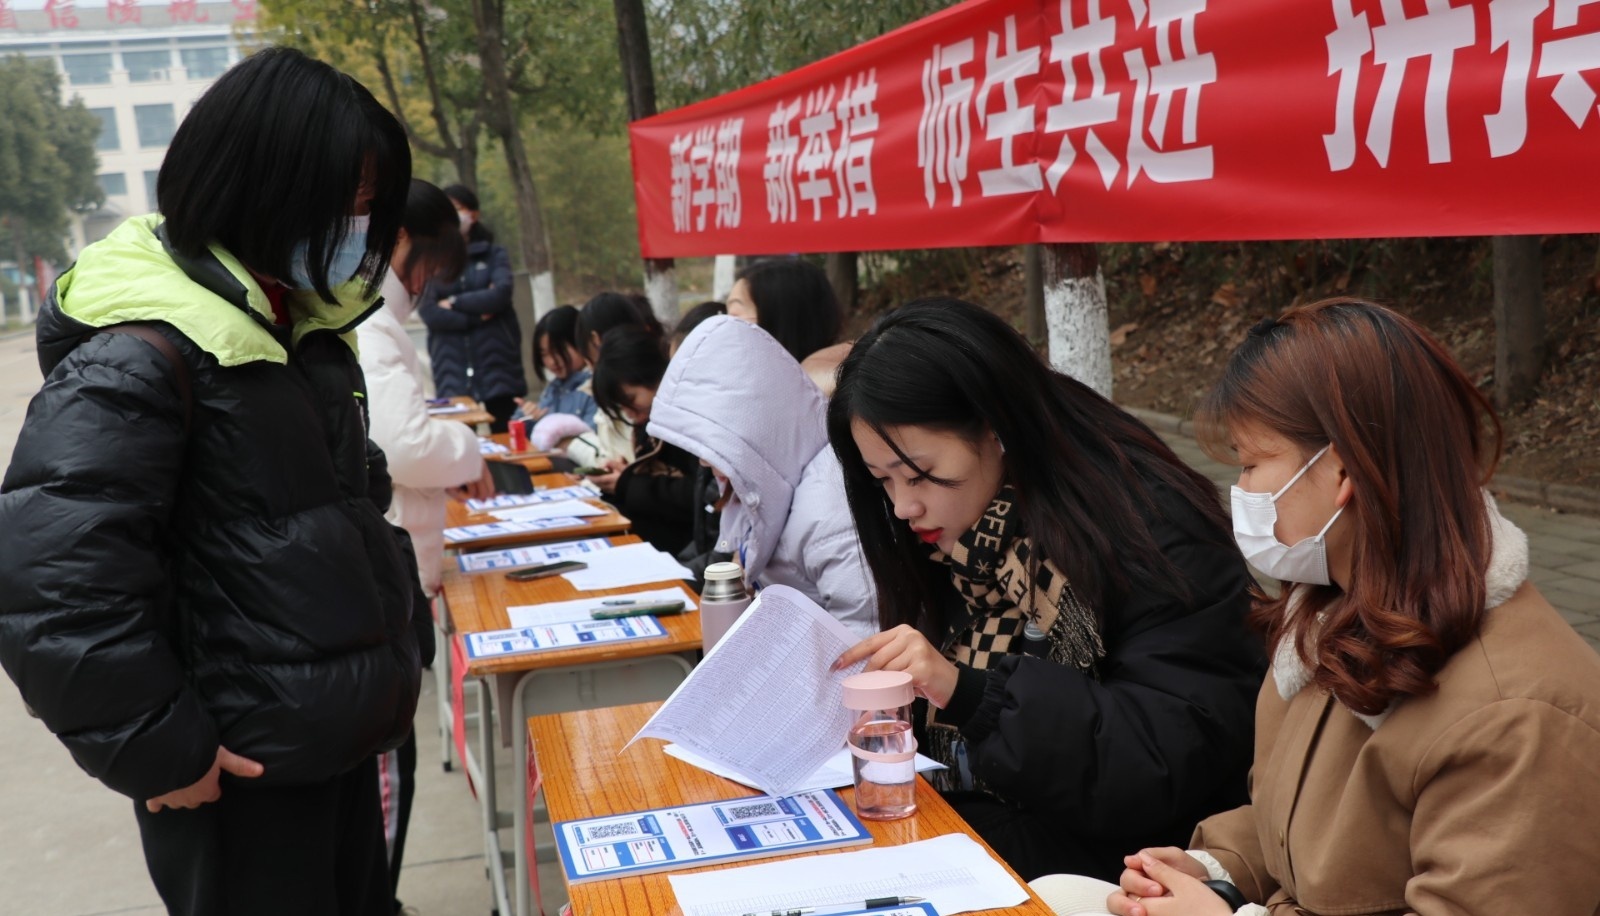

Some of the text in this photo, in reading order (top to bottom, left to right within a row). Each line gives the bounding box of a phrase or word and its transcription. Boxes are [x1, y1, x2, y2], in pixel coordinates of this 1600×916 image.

[669, 117, 744, 233] 新学期
[763, 67, 879, 224] 新举措
[918, 0, 1217, 209] 师生共进
